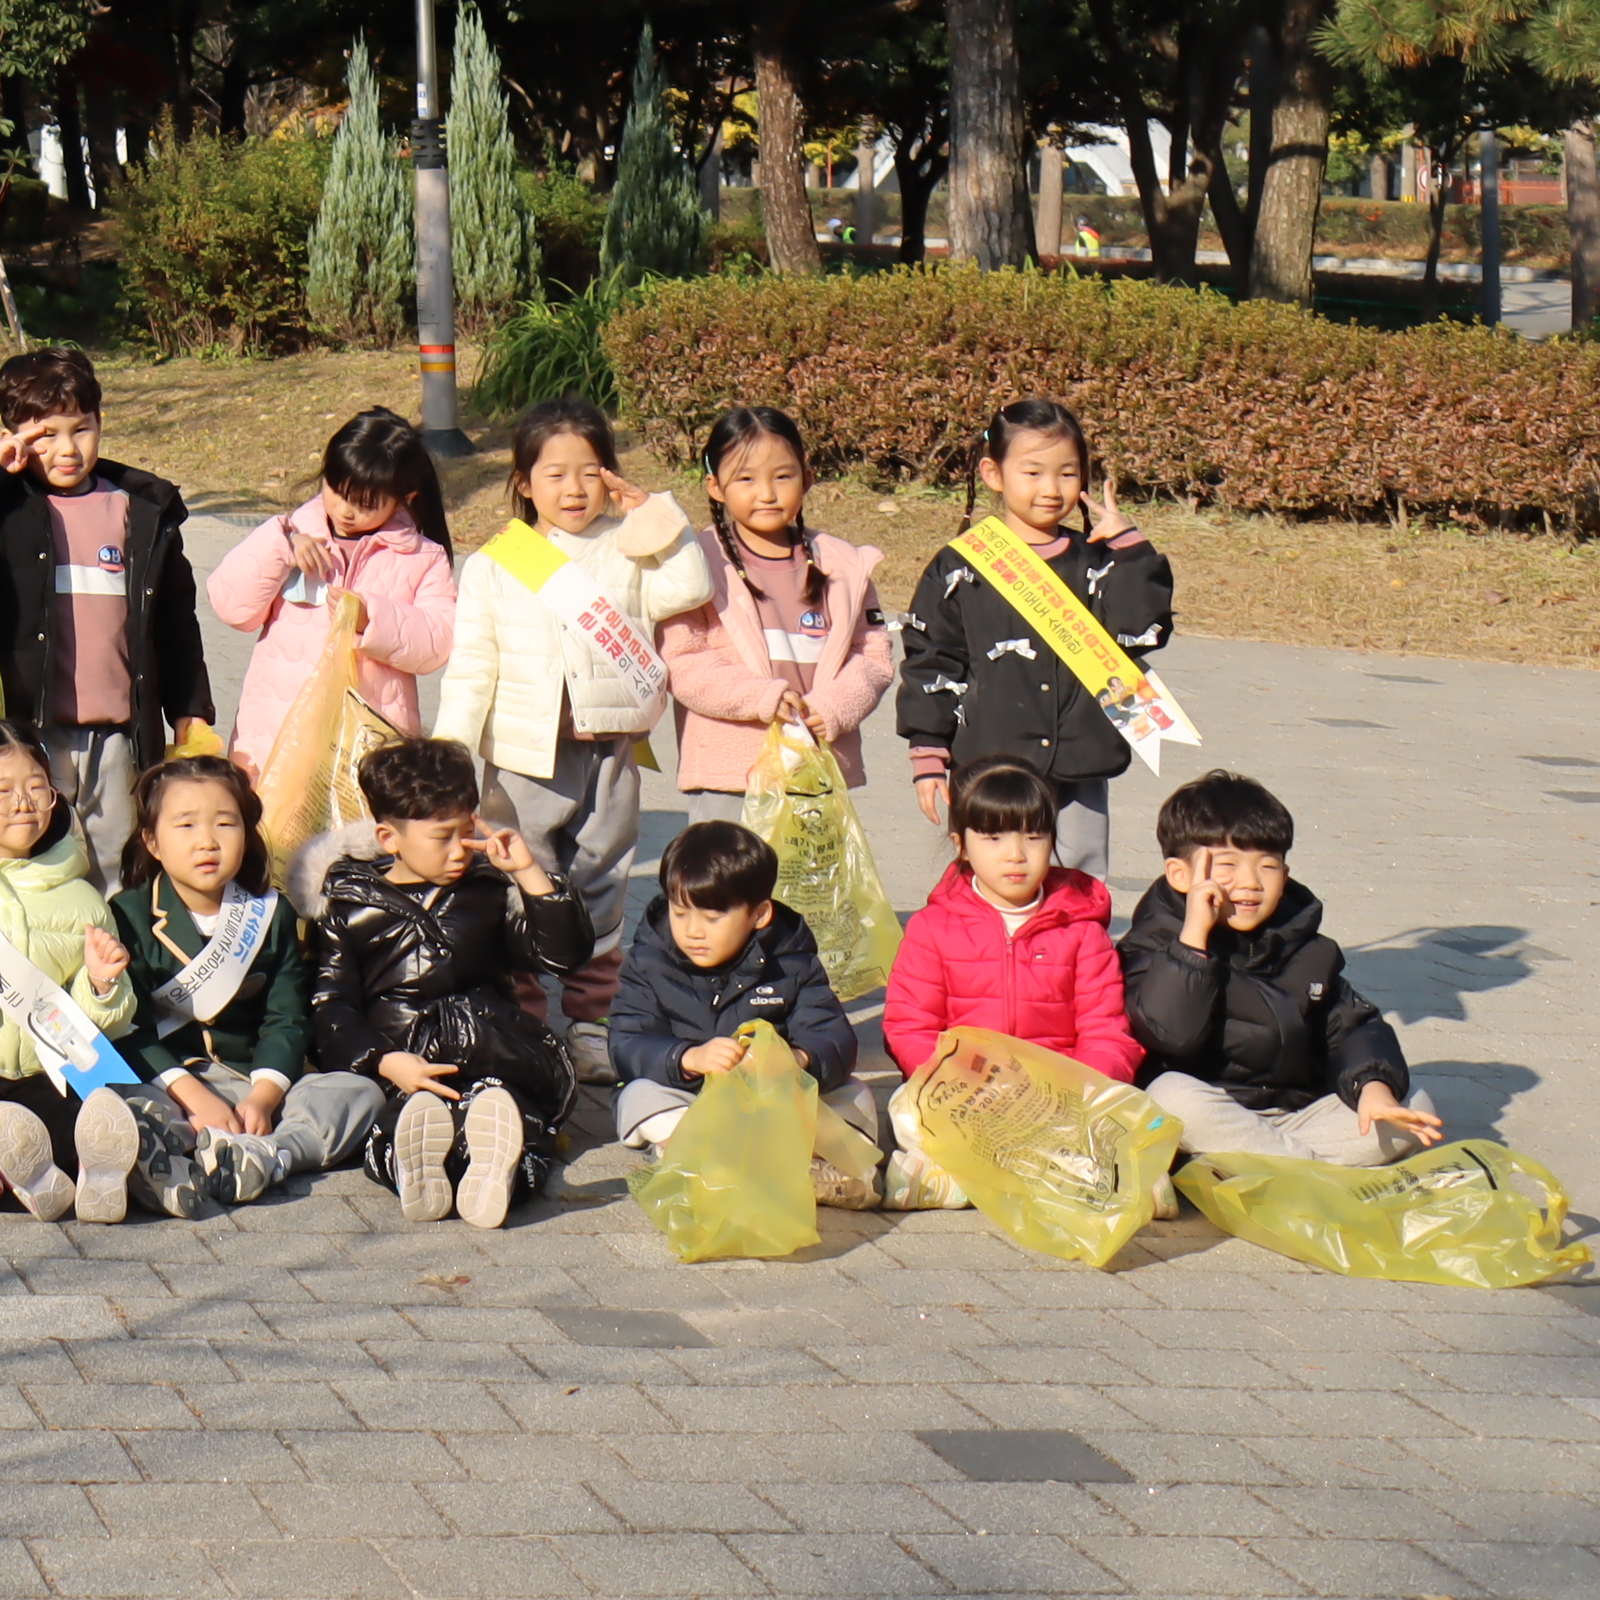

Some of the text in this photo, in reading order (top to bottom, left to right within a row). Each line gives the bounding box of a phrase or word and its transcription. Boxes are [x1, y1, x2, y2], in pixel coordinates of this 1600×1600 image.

[1005, 548, 1042, 584] 안전을
[591, 596, 623, 631] 작은
[1048, 616, 1083, 655] 소중한
[577, 611, 653, 700] 큰 화재의 시작
[234, 917, 260, 964] 소화기
